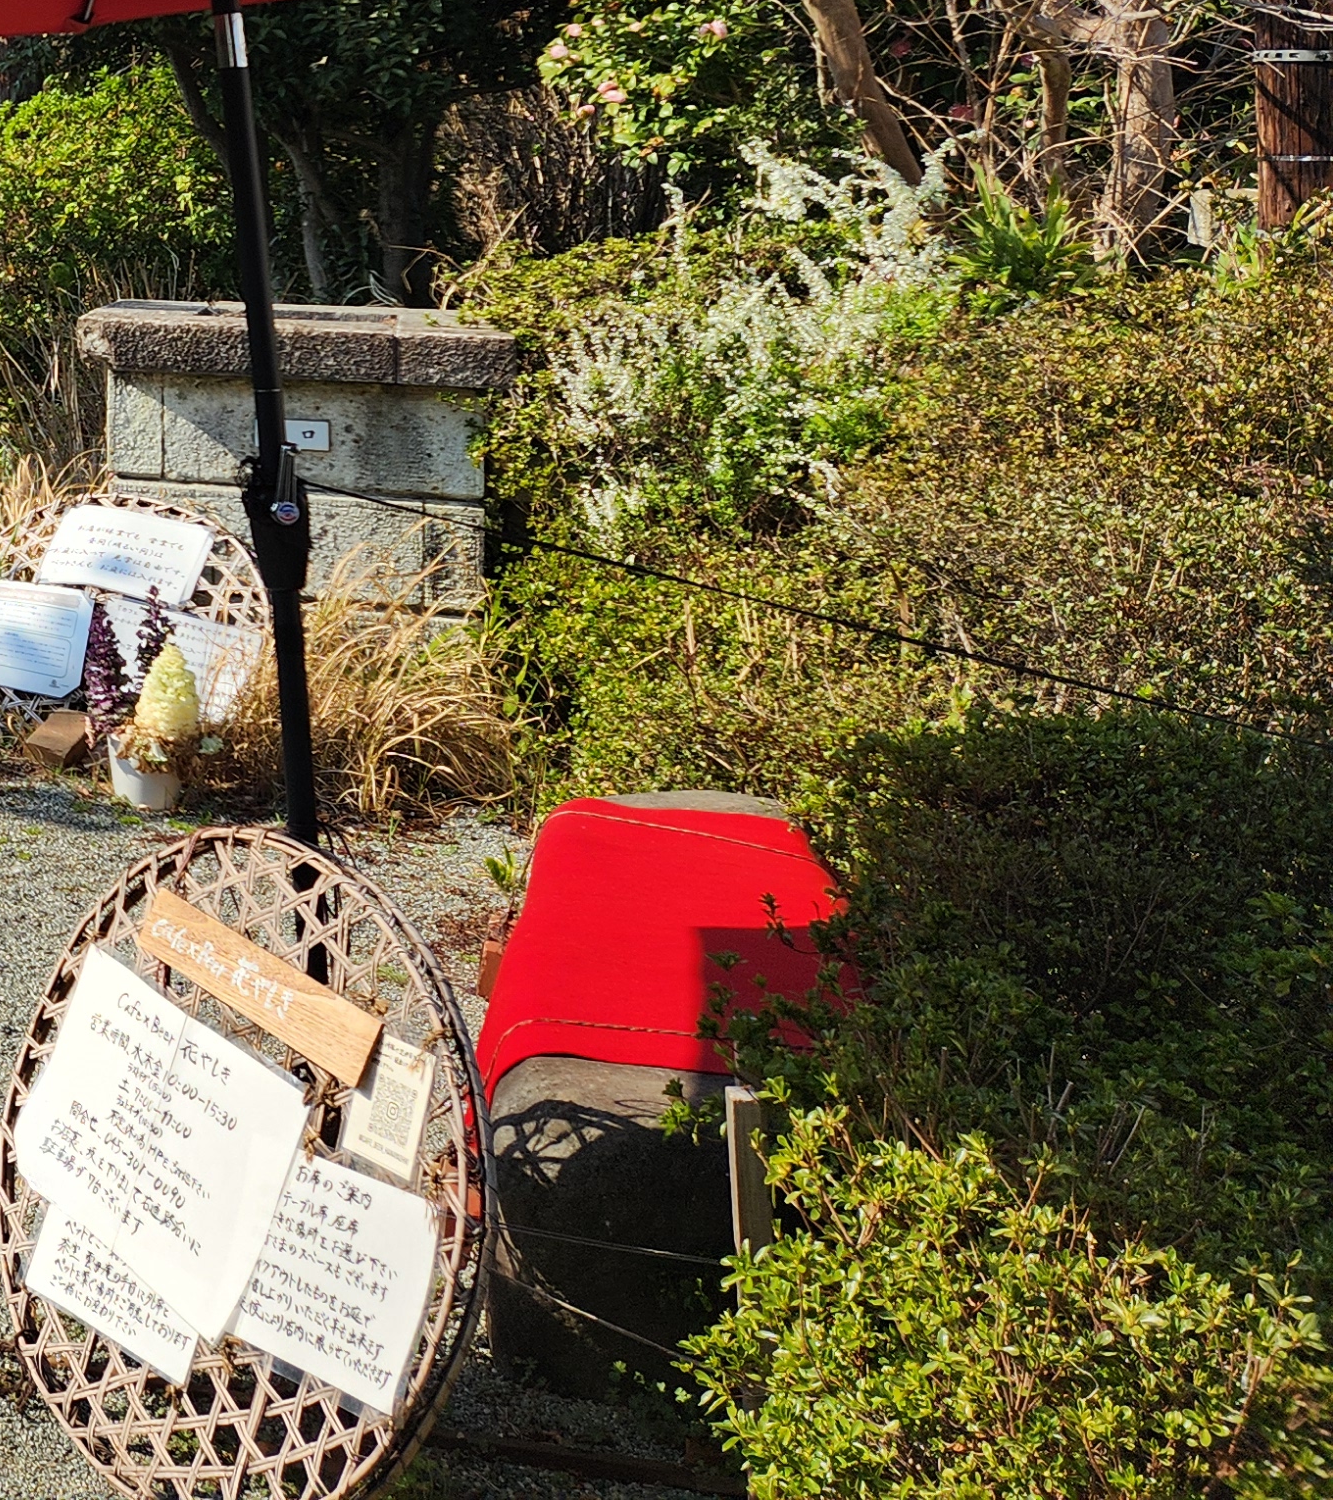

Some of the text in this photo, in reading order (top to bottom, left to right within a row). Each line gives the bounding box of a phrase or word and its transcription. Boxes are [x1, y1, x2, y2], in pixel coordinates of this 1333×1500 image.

[179, 1036, 232, 1086] 花やしき
[273, 1212, 398, 1280] きな場所をお選び下さい
